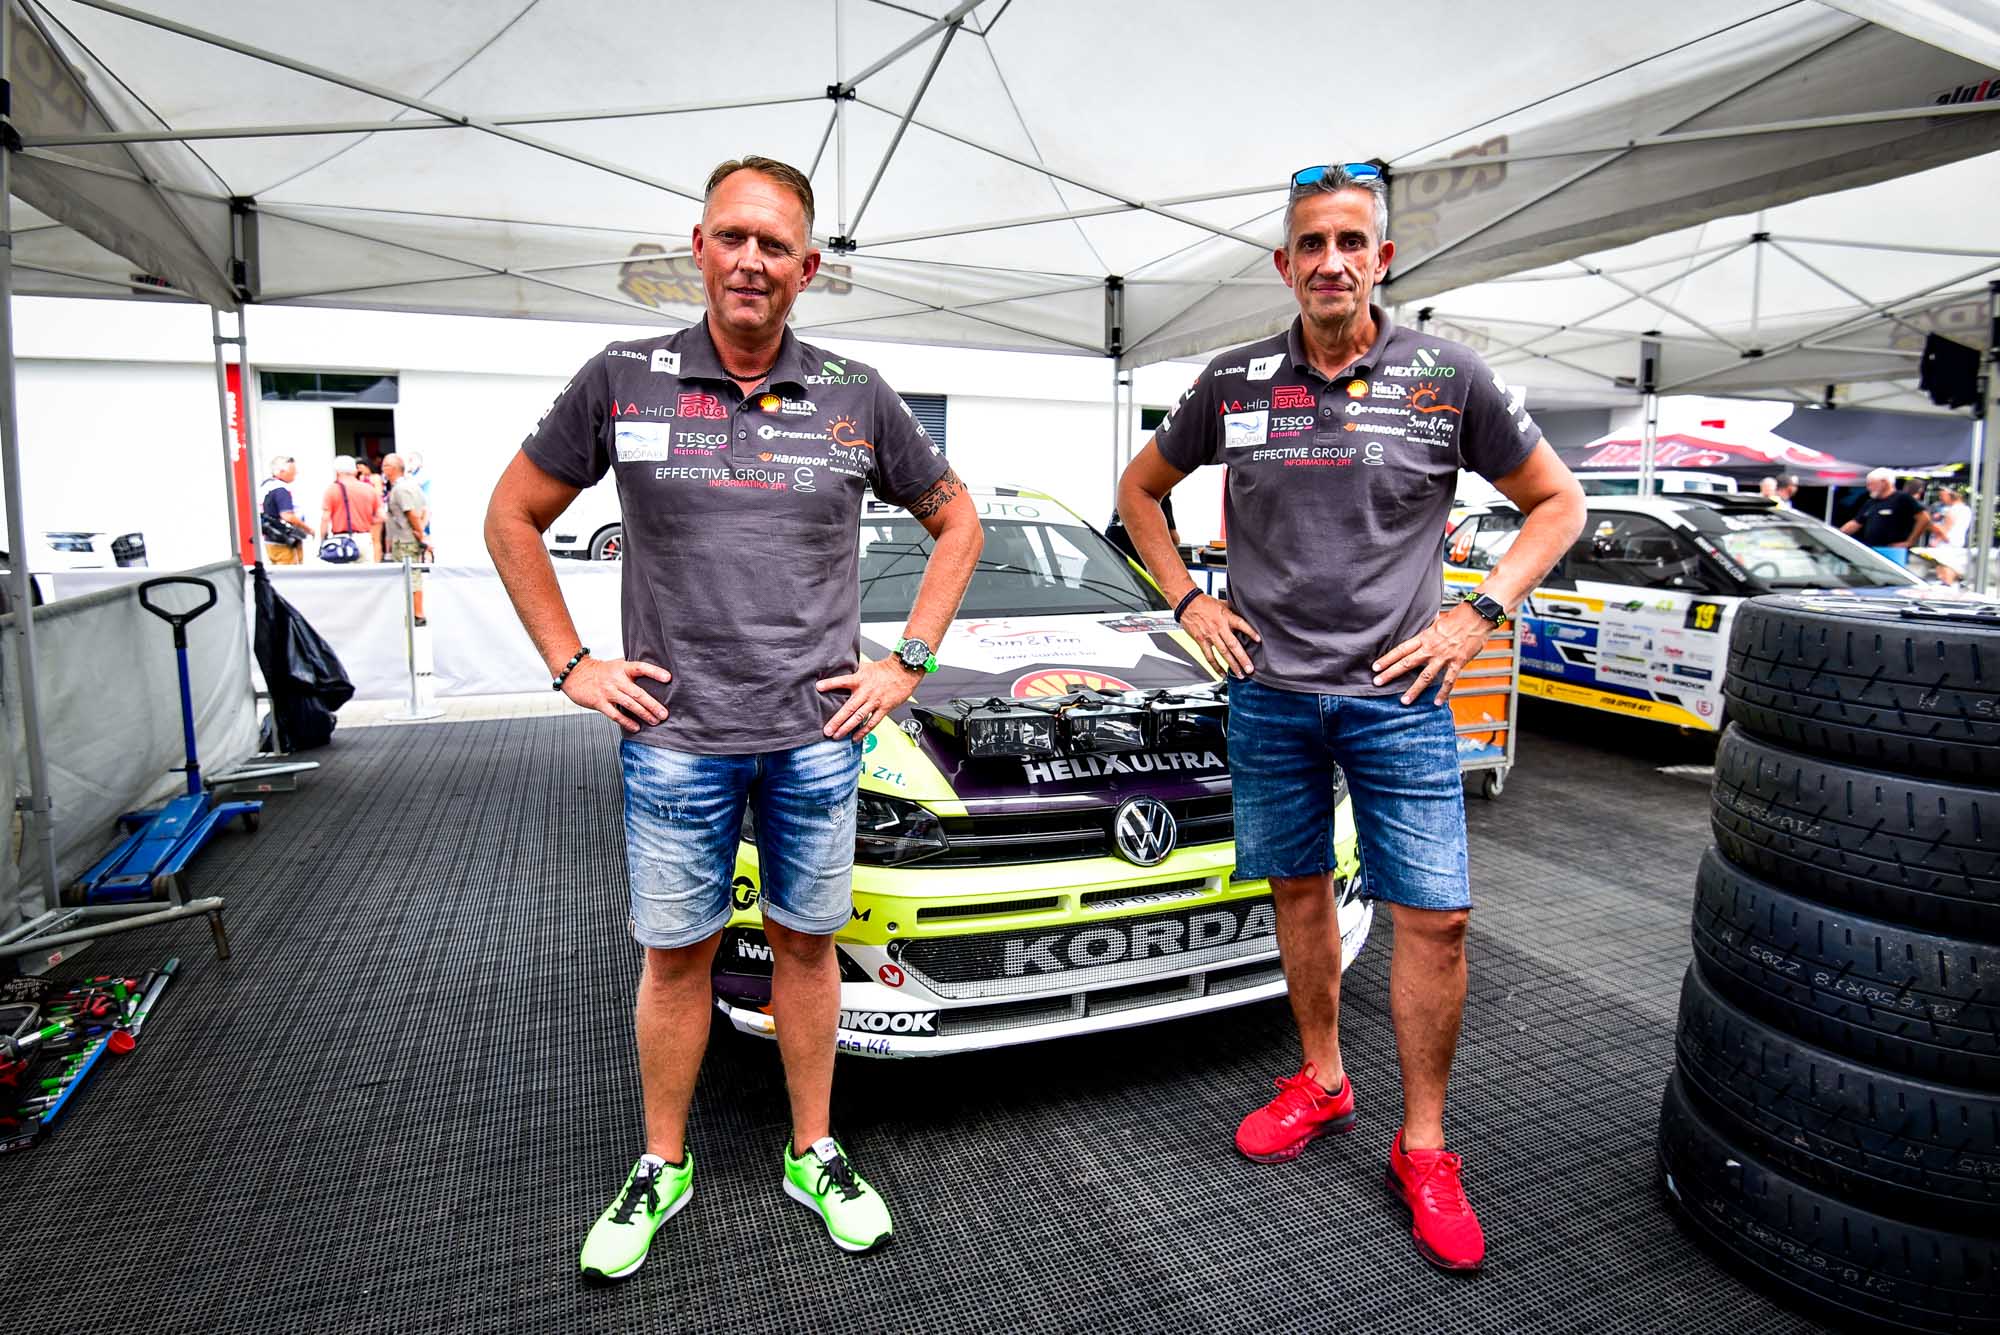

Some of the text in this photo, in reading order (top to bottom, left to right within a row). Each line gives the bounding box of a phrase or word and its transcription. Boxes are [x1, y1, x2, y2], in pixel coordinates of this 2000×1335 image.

[1383, 366, 1456, 378] NEXTAUTO
[1272, 416, 1314, 428] TESCO
[1407, 414, 1454, 433] Sun & Fun
[676, 432, 728, 445] TESCO
[828, 443, 848, 459] Sun
[849, 446, 858, 464] &
[1252, 448, 1357, 461] EFFECTIVE GROUP
[655, 467, 785, 483] EFFECTIVE GROUP
[1694, 604, 1717, 629] 19
[872, 765, 906, 787] Zrt.
[1022, 751, 1225, 784] HELIX ULTRA
[1004, 903, 1277, 977] KORDA
